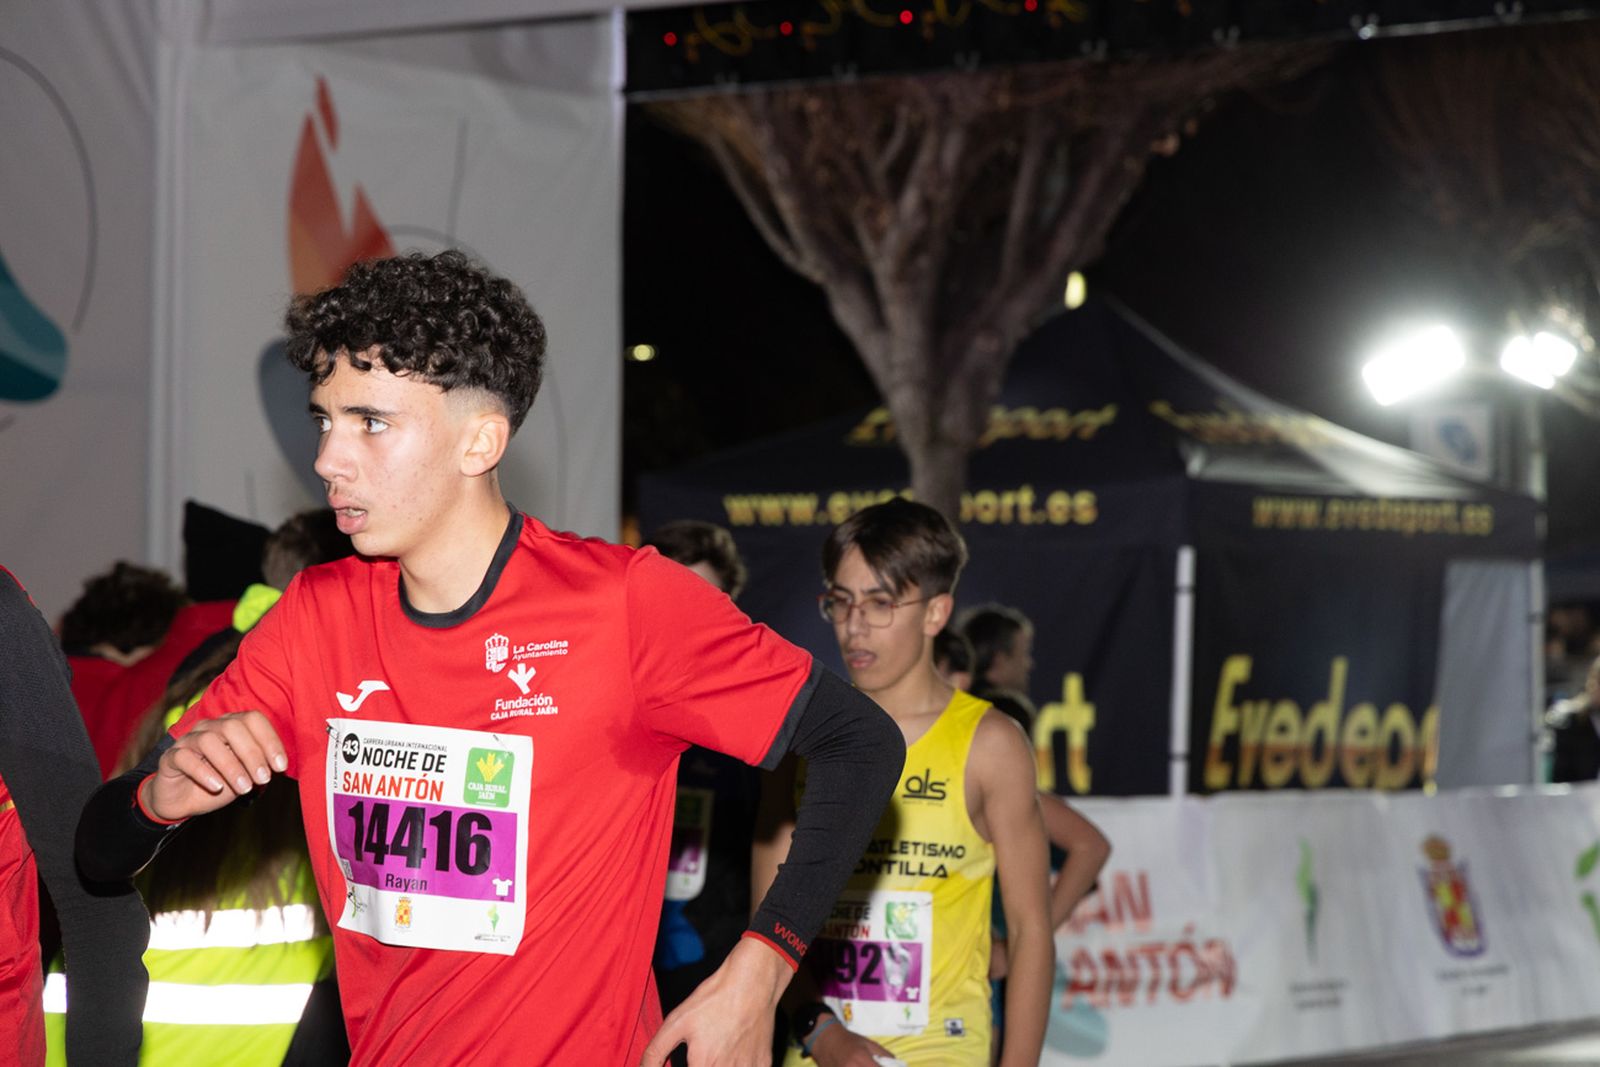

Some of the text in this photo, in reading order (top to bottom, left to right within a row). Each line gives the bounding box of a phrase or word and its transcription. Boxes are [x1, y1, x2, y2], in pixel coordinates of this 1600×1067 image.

[512, 648, 568, 661] Ayuntamiento
[513, 640, 569, 655] La Carolina
[495, 693, 553, 711] Fundación
[490, 705, 558, 721] CAJA RURAL JAÉN
[342, 739, 360, 756] 43
[361, 747, 447, 773] NOCHE DE
[342, 771, 444, 802] SAN ANTÓN
[348, 800, 493, 876] 14416
[867, 838, 966, 860] ATLETISMO
[854, 858, 949, 879] ONTILLA
[385, 873, 428, 892] Rayan
[1061, 922, 1238, 1012] ANTÓN
